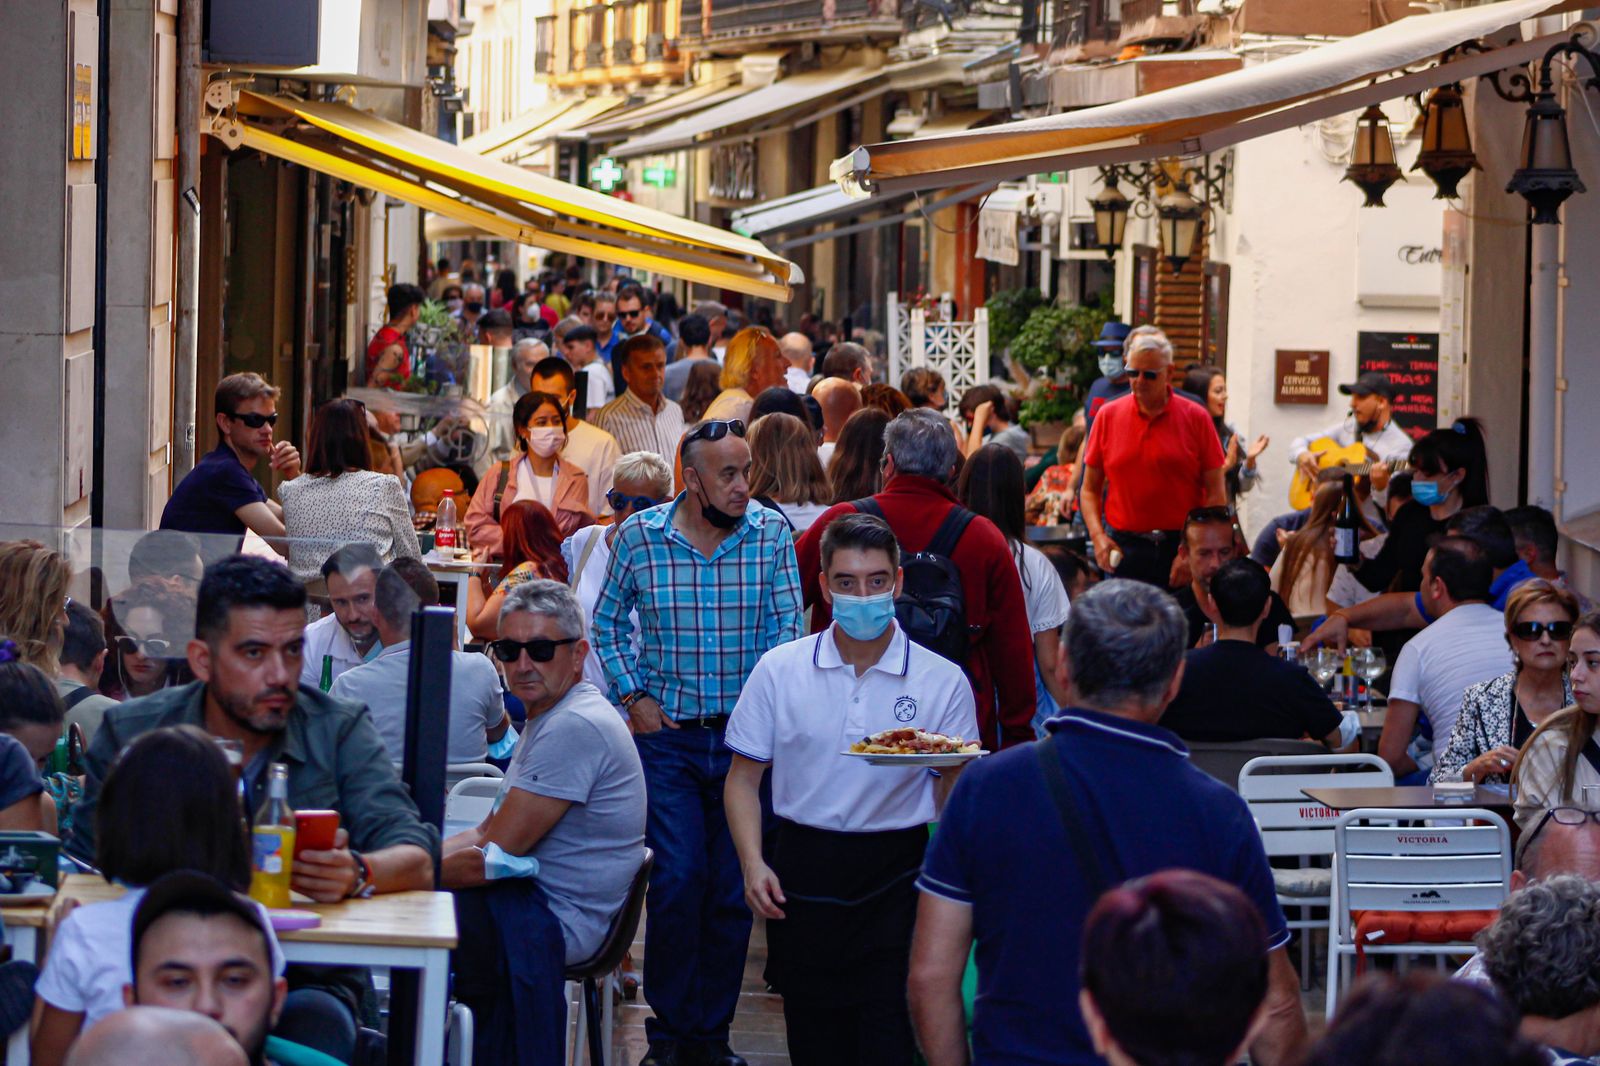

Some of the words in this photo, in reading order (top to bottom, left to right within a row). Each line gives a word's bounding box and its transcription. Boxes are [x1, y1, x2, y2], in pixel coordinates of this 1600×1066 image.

[1283, 375, 1319, 385] CERVEZAS
[1281, 386, 1322, 396] ALHAMBRA
[1299, 807, 1340, 818] VICTORIA
[1397, 836, 1448, 844] VICTORIA
